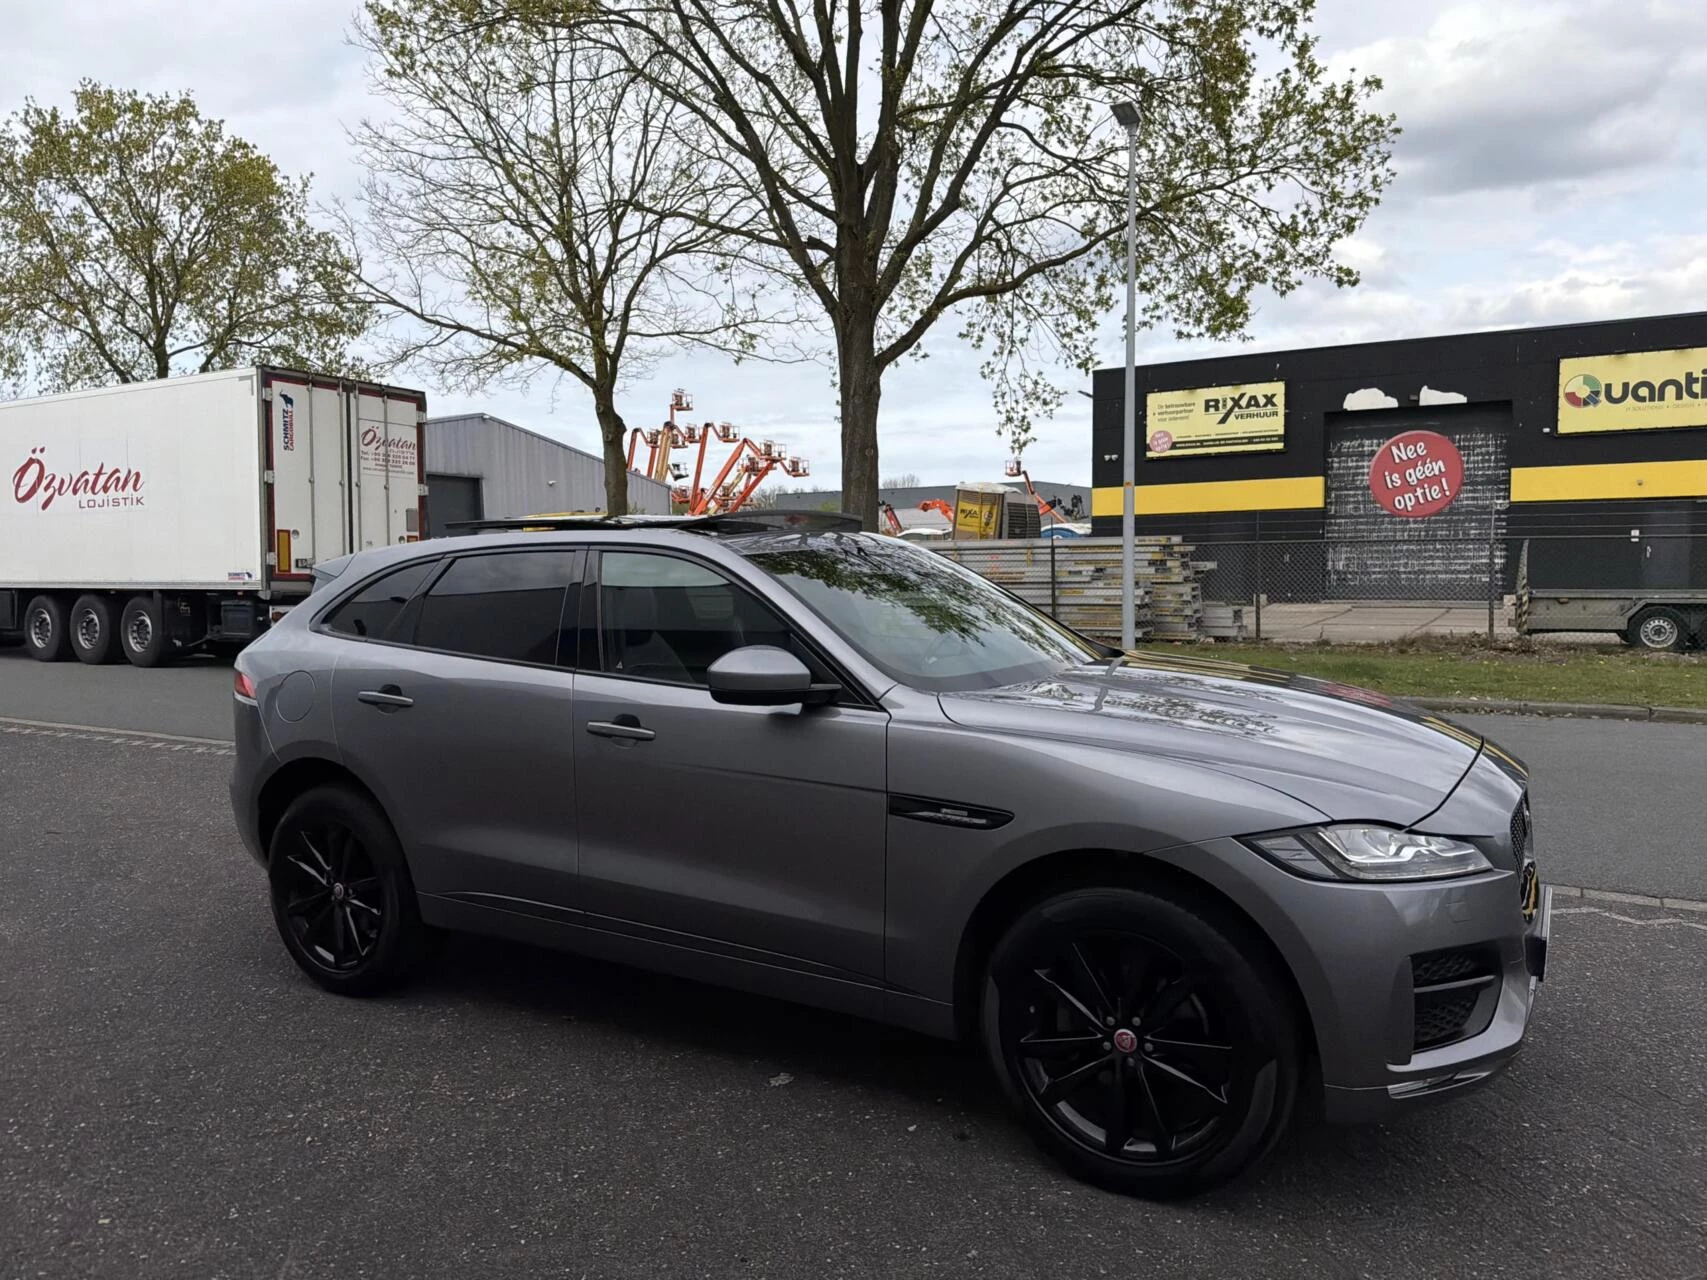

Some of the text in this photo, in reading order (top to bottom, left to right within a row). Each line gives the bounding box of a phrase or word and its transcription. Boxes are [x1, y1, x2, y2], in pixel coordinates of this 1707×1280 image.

[1234, 411, 1279, 420] VERHUUR
[360, 425, 416, 451] Özvatan
[1391, 441, 1427, 463] Nee
[12, 446, 145, 511] Özvatan
[1384, 458, 1446, 489] is géén
[79, 493, 145, 509] LOJİSTİK
[1394, 477, 1450, 512] optie!
